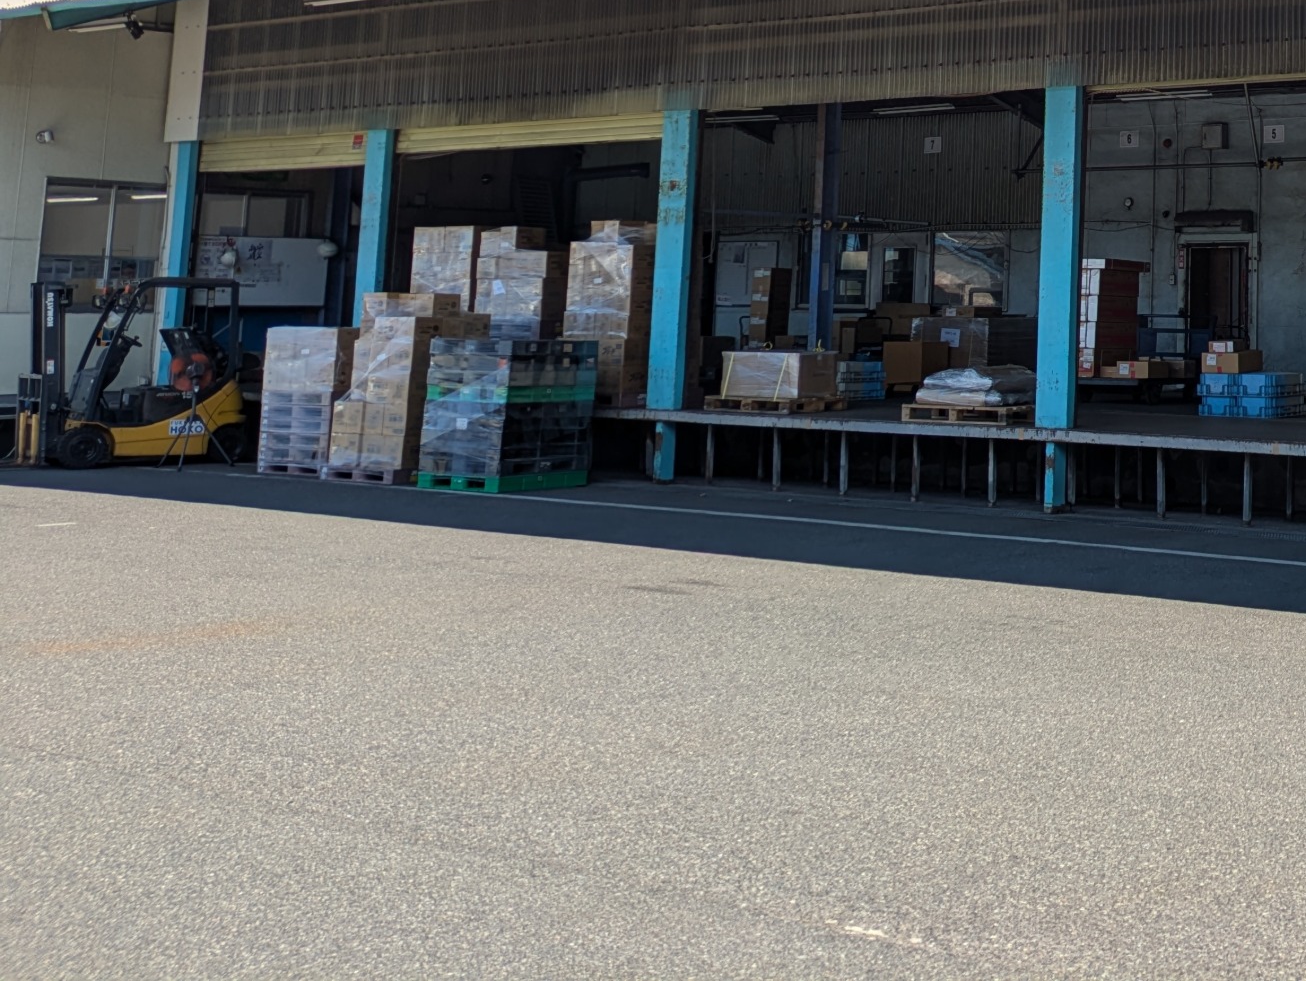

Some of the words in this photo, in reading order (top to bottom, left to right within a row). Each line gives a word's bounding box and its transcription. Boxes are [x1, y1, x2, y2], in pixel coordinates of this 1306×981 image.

[1127, 134, 1132, 144] 6
[1271, 128, 1277, 140] 5
[46, 292, 55, 328] KOMATSU
